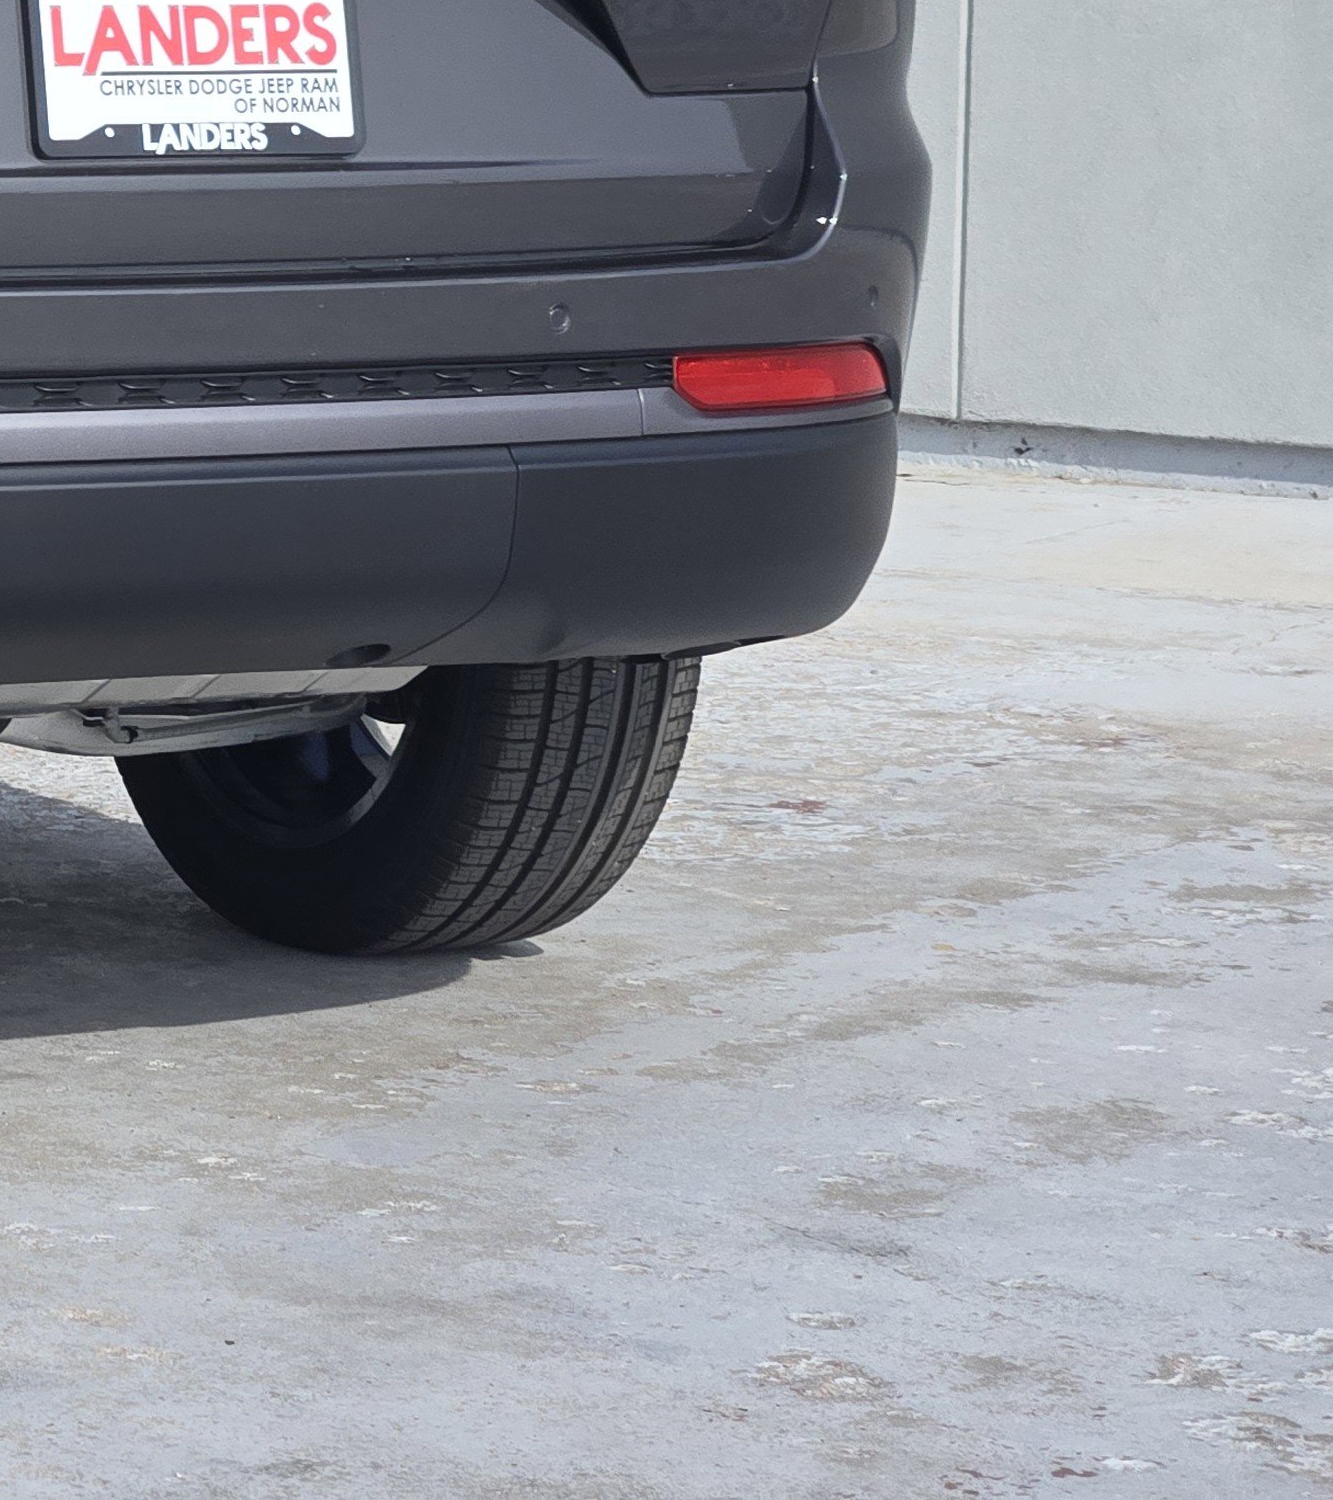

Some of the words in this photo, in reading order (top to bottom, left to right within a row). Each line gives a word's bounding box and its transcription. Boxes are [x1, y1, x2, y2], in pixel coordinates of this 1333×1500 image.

[49, 2, 338, 77] LANDERS
[99, 78, 184, 97] CHRYSLER
[188, 78, 253, 96] DODGE
[257, 77, 295, 95] JEEP
[300, 77, 339, 94] RAM
[233, 98, 258, 115] OF
[262, 97, 341, 114] NORMAN
[141, 122, 269, 156] LANDERS
